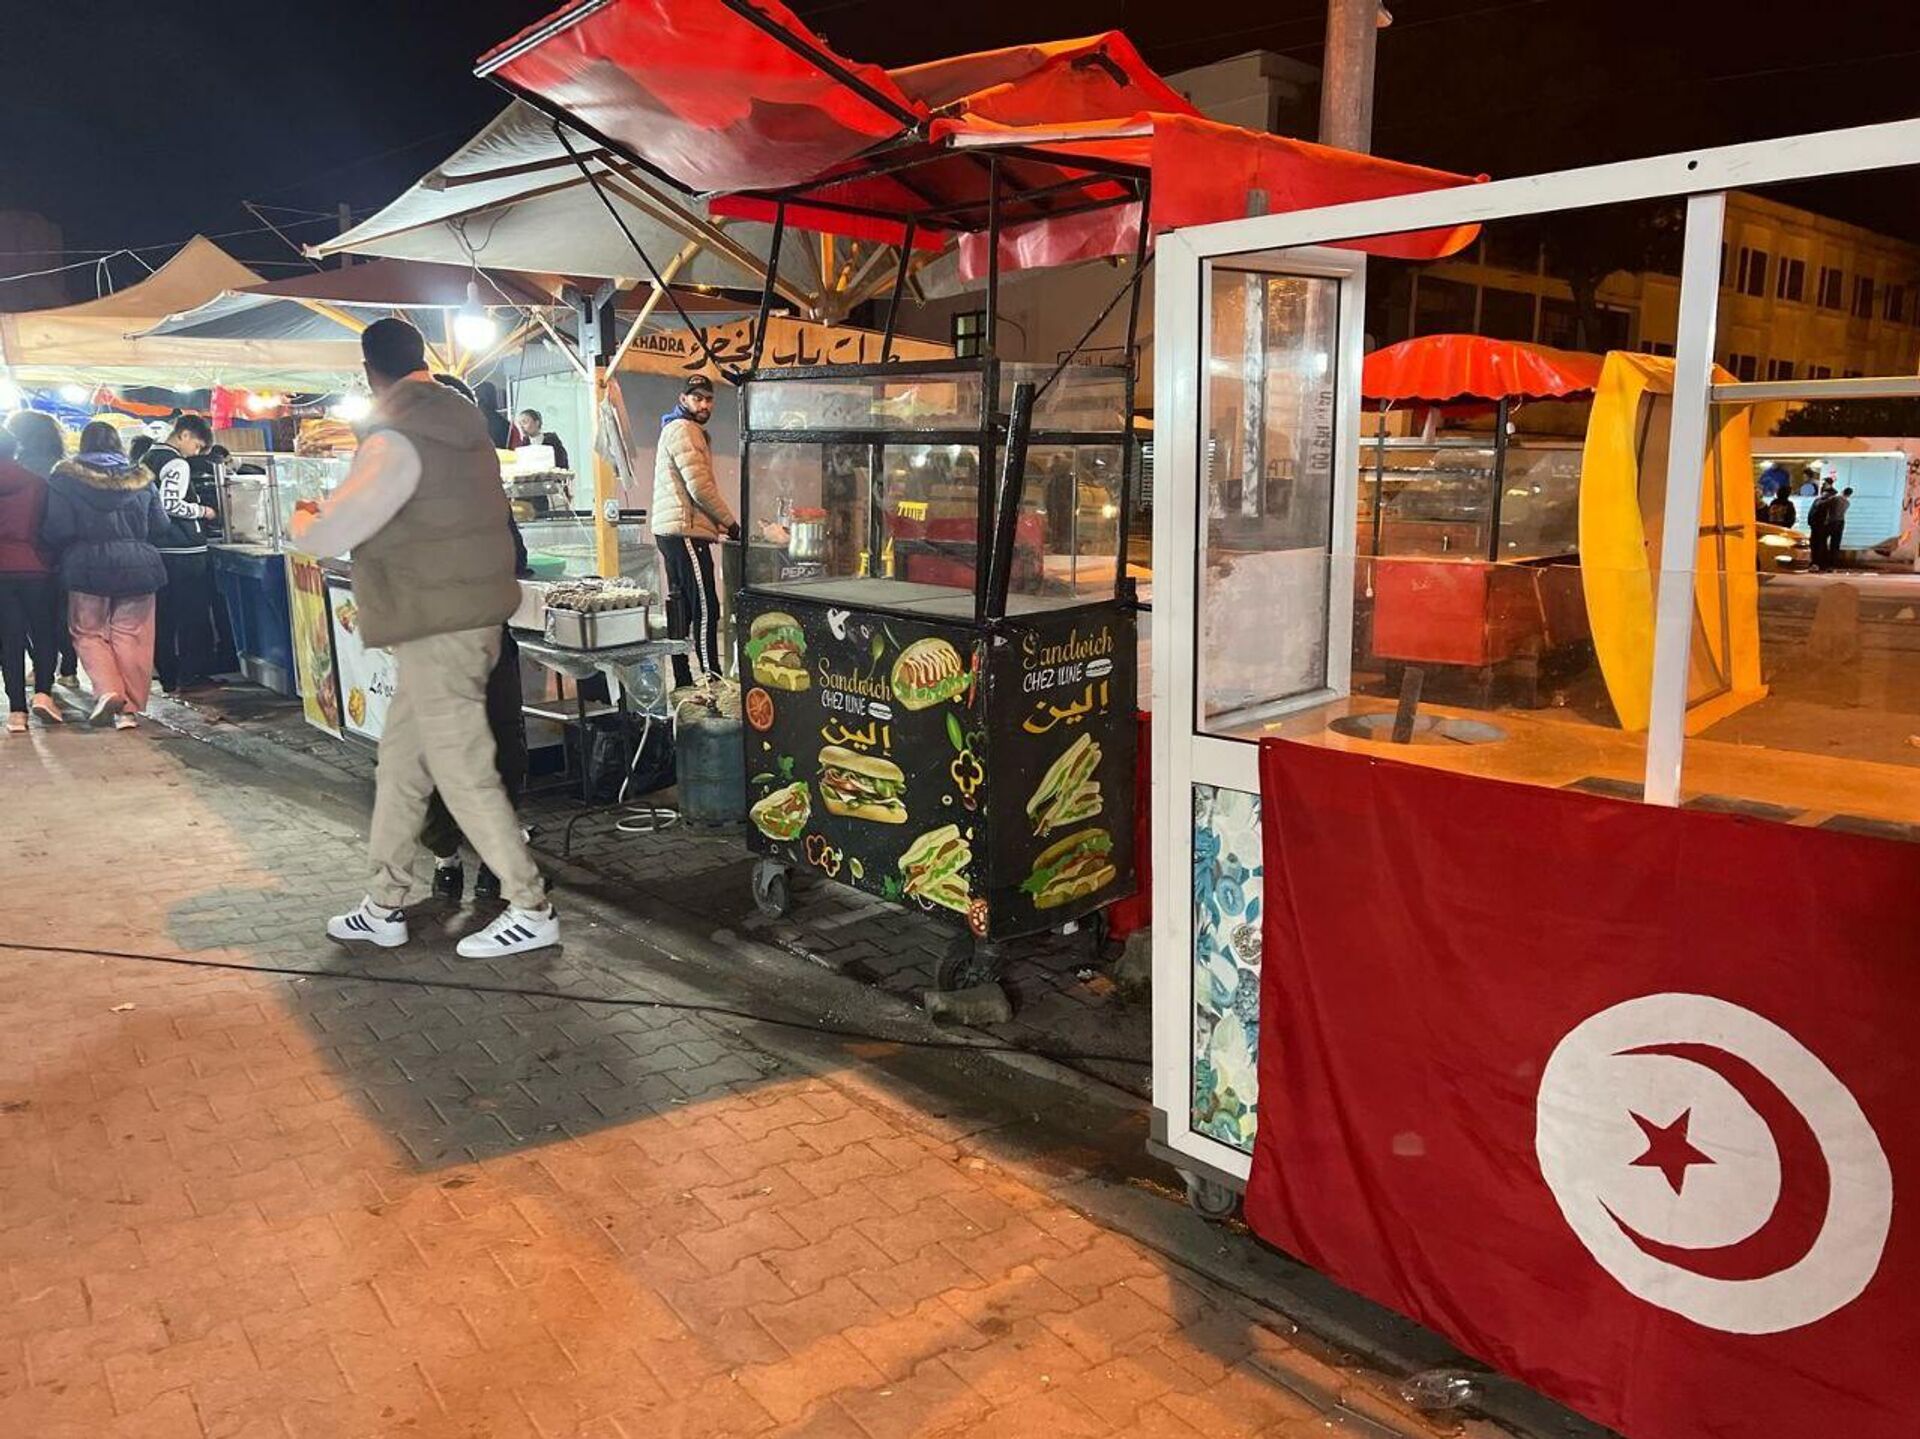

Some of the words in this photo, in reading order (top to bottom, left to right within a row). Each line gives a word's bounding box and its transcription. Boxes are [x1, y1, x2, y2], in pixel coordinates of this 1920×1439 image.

[1022, 625, 1113, 671] Sandwich
[818, 656, 893, 701] Sandwich
[1022, 668, 1055, 693] CHEZ
[821, 689, 844, 711] CHEZ
